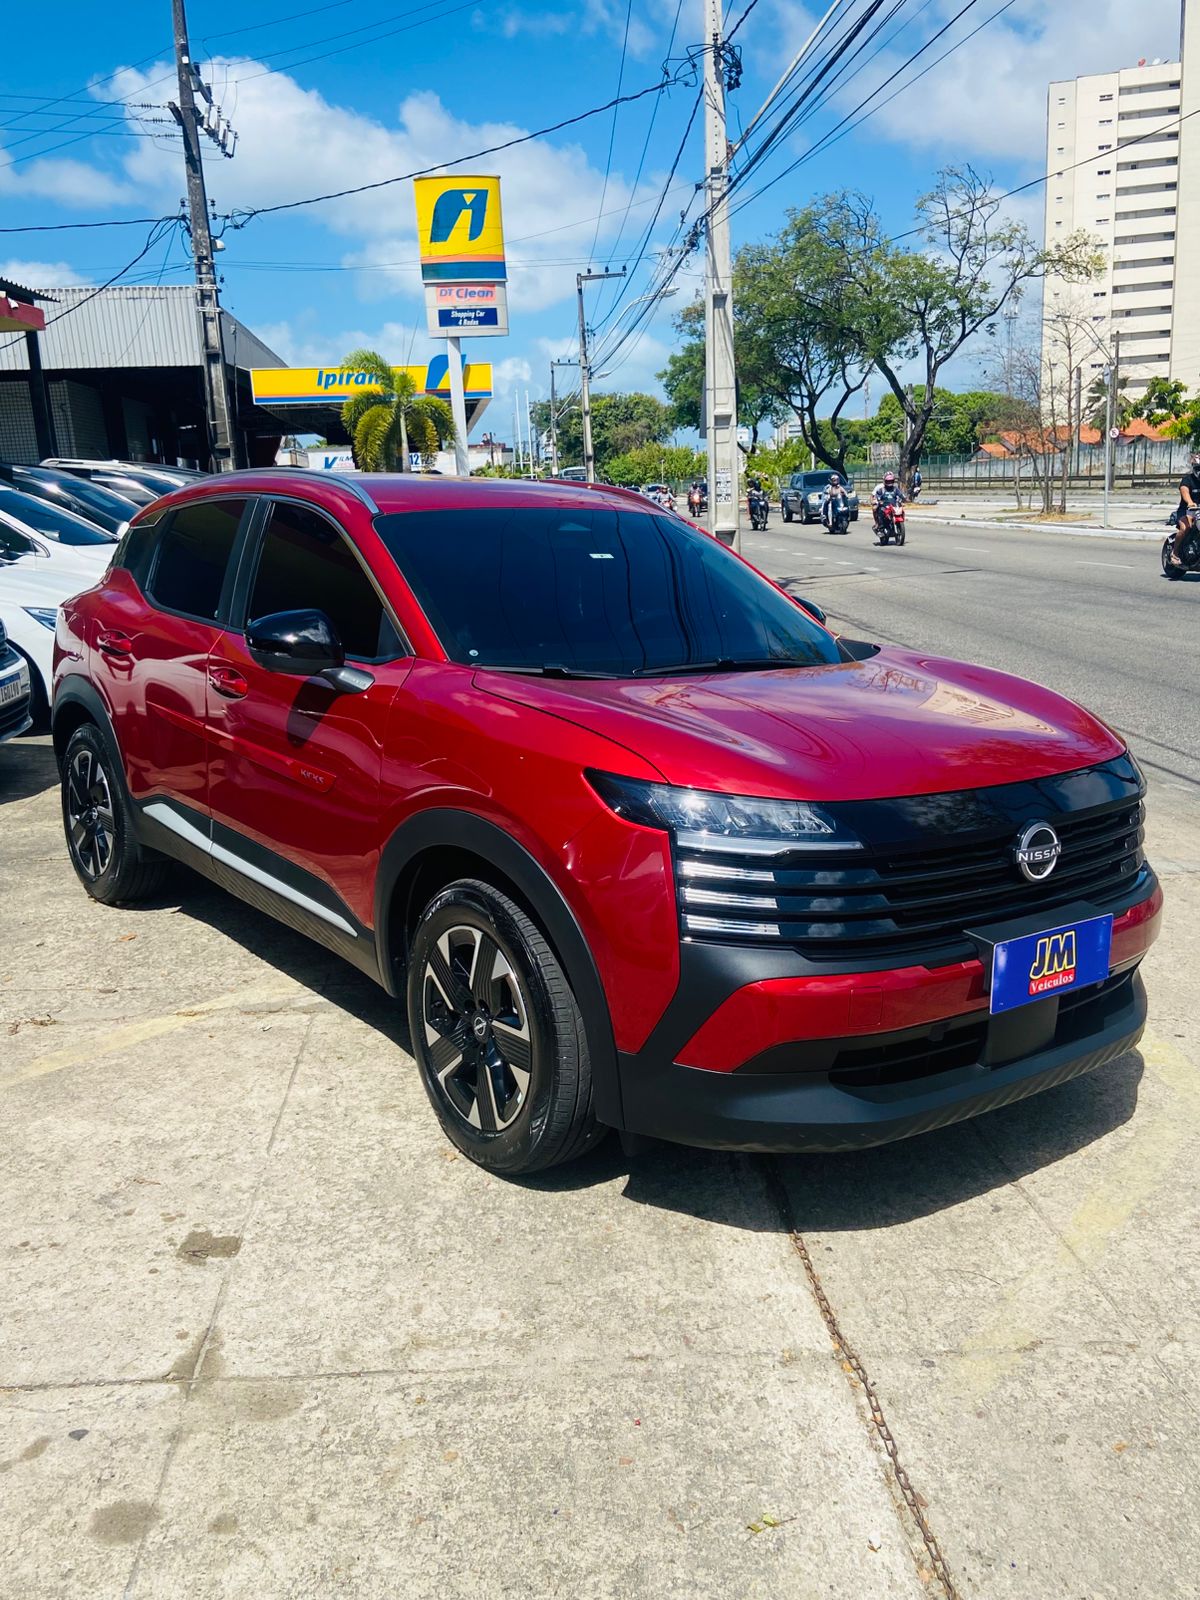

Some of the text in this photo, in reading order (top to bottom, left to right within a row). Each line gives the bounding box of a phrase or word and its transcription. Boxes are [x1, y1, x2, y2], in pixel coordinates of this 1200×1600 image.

[440, 288, 494, 298] DT Clean
[317, 370, 379, 390] Ipiran
[1018, 844, 1062, 862] NISSAN
[1029, 930, 1076, 980] JM
